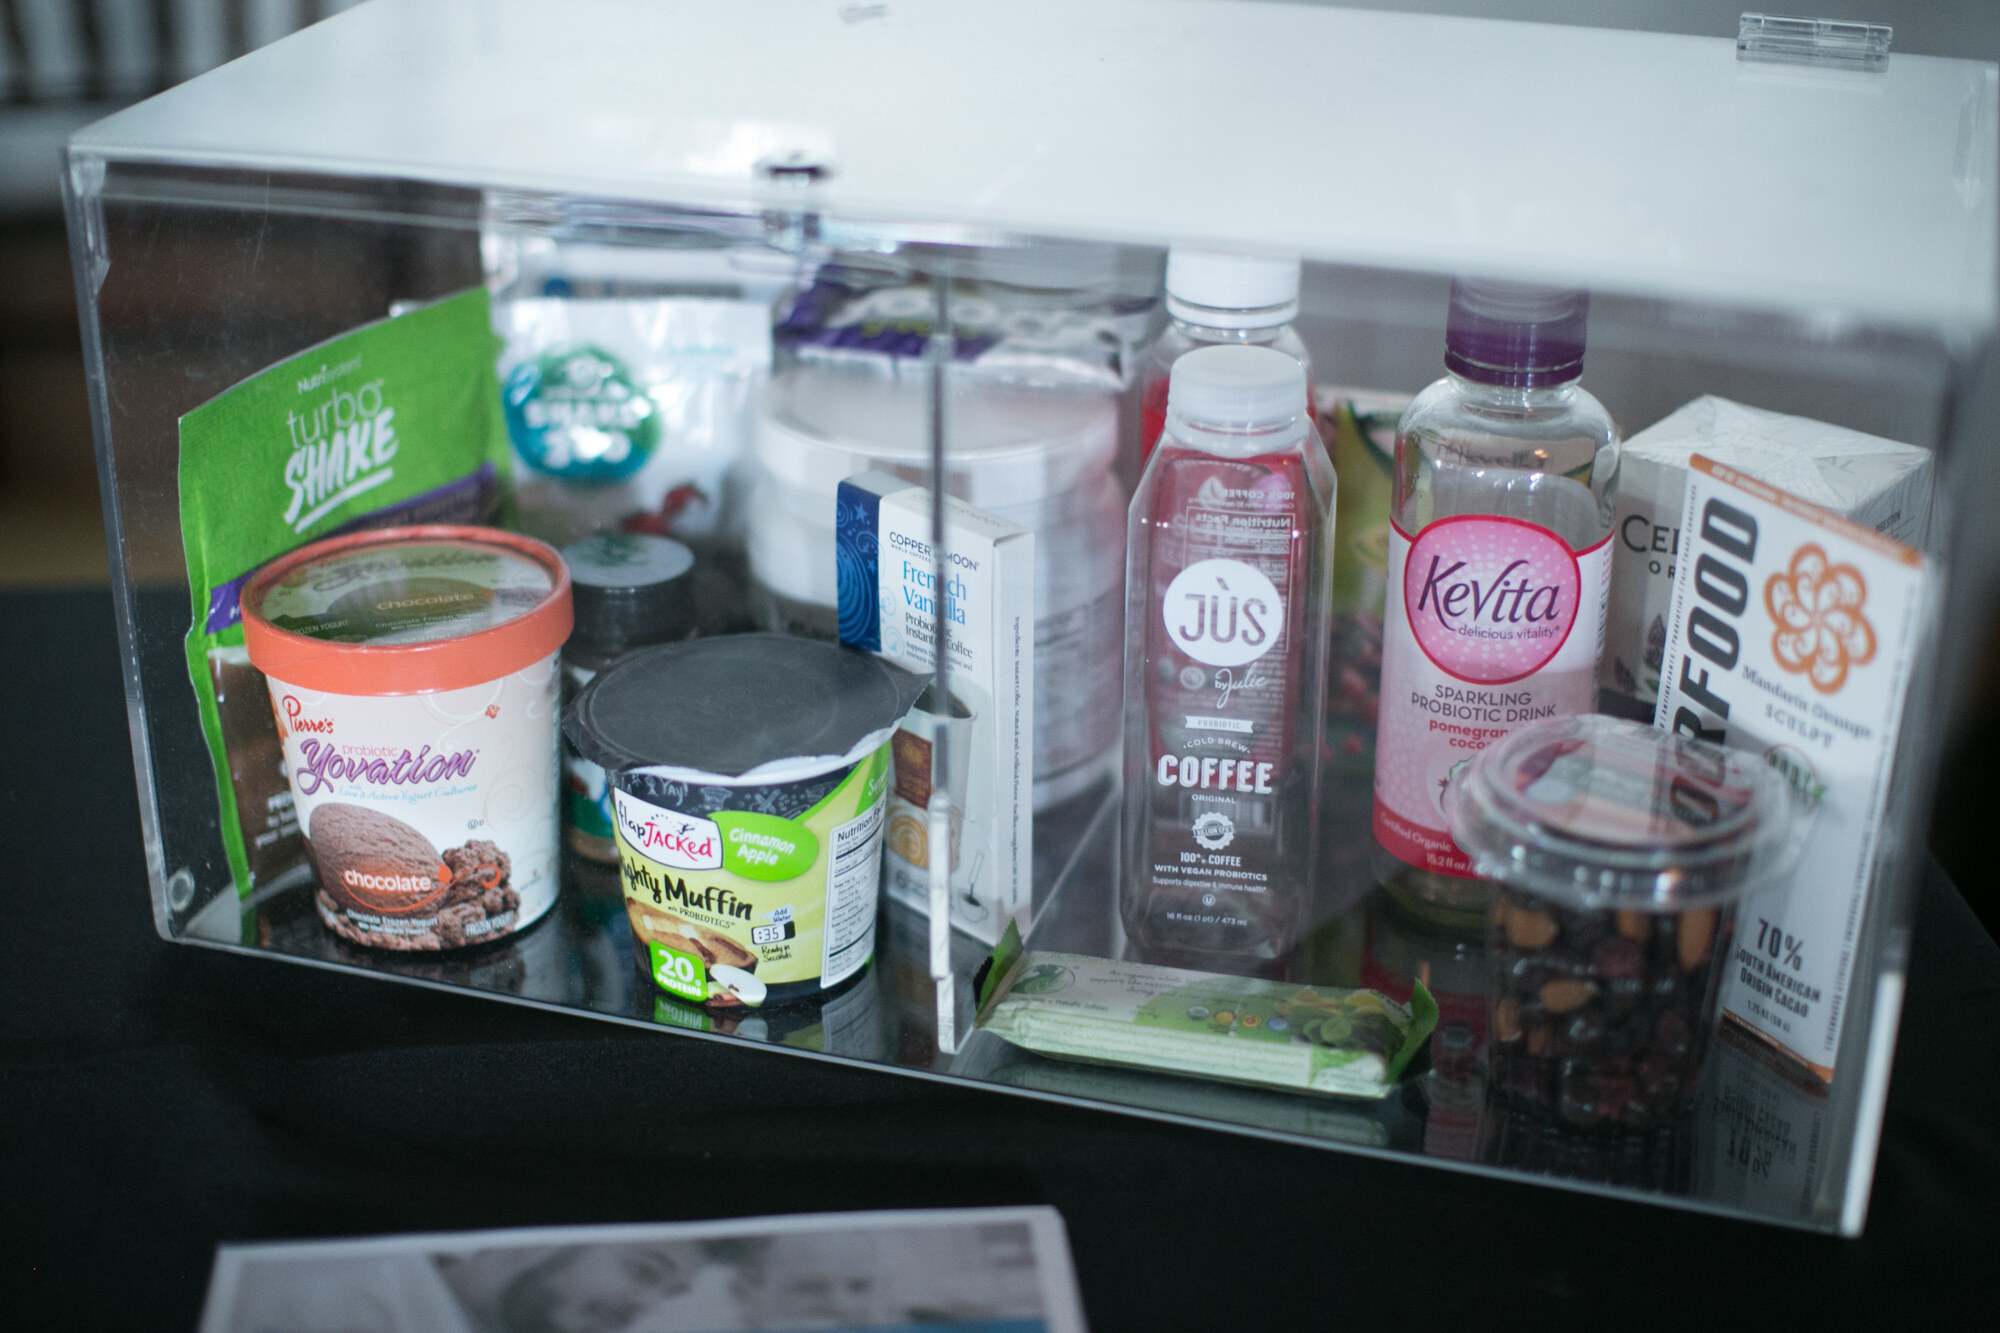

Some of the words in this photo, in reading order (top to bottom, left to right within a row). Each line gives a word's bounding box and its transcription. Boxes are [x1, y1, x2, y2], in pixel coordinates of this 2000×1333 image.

[287, 382, 382, 449] turbo
[284, 407, 399, 524] SHAKE
[889, 531, 931, 557] COPPER
[903, 560, 967, 600] French
[375, 591, 475, 611] chocolate
[1178, 577, 1268, 646] JÙS
[906, 625, 934, 645] Instant
[1459, 624, 1513, 639] delicious
[1214, 680, 1227, 690] by
[1435, 684, 1532, 706] SPARKLING
[282, 695, 334, 734] Pierre's
[1411, 692, 1501, 722] PROBIOTIC
[1506, 704, 1557, 722] DRINK
[342, 744, 398, 758] probiotic
[1187, 737, 1214, 748] COLD
[1217, 737, 1248, 752] BREW
[297, 738, 477, 795] Yovation
[1158, 754, 1273, 794] COFFEE
[1191, 793, 1236, 804] ORIGINAL
[837, 814, 873, 842] Nutrition
[729, 828, 796, 855] Cinnamon
[1412, 832, 1452, 852] Organic
[737, 844, 779, 865] Apple
[1180, 852, 1206, 864] 100%
[1208, 854, 1242, 867] COFFEE
[344, 869, 432, 892] chocolate
[1152, 876, 1182, 886] Supports
[1154, 864, 1179, 873] WITH
[1181, 866, 1212, 876] VEGAN
[1214, 869, 1268, 881] PROBIOTICS
[664, 873, 753, 920] Muffin
[761, 945, 783, 955] Ready
[1757, 918, 1803, 971] 70%
[763, 951, 792, 963] Seconds
[656, 973, 702, 997] PROTEIN
[1741, 967, 1773, 999] ORIGIN
[1775, 988, 1810, 1018] CACAO
[1765, 962, 1821, 1003] AMERICAN
